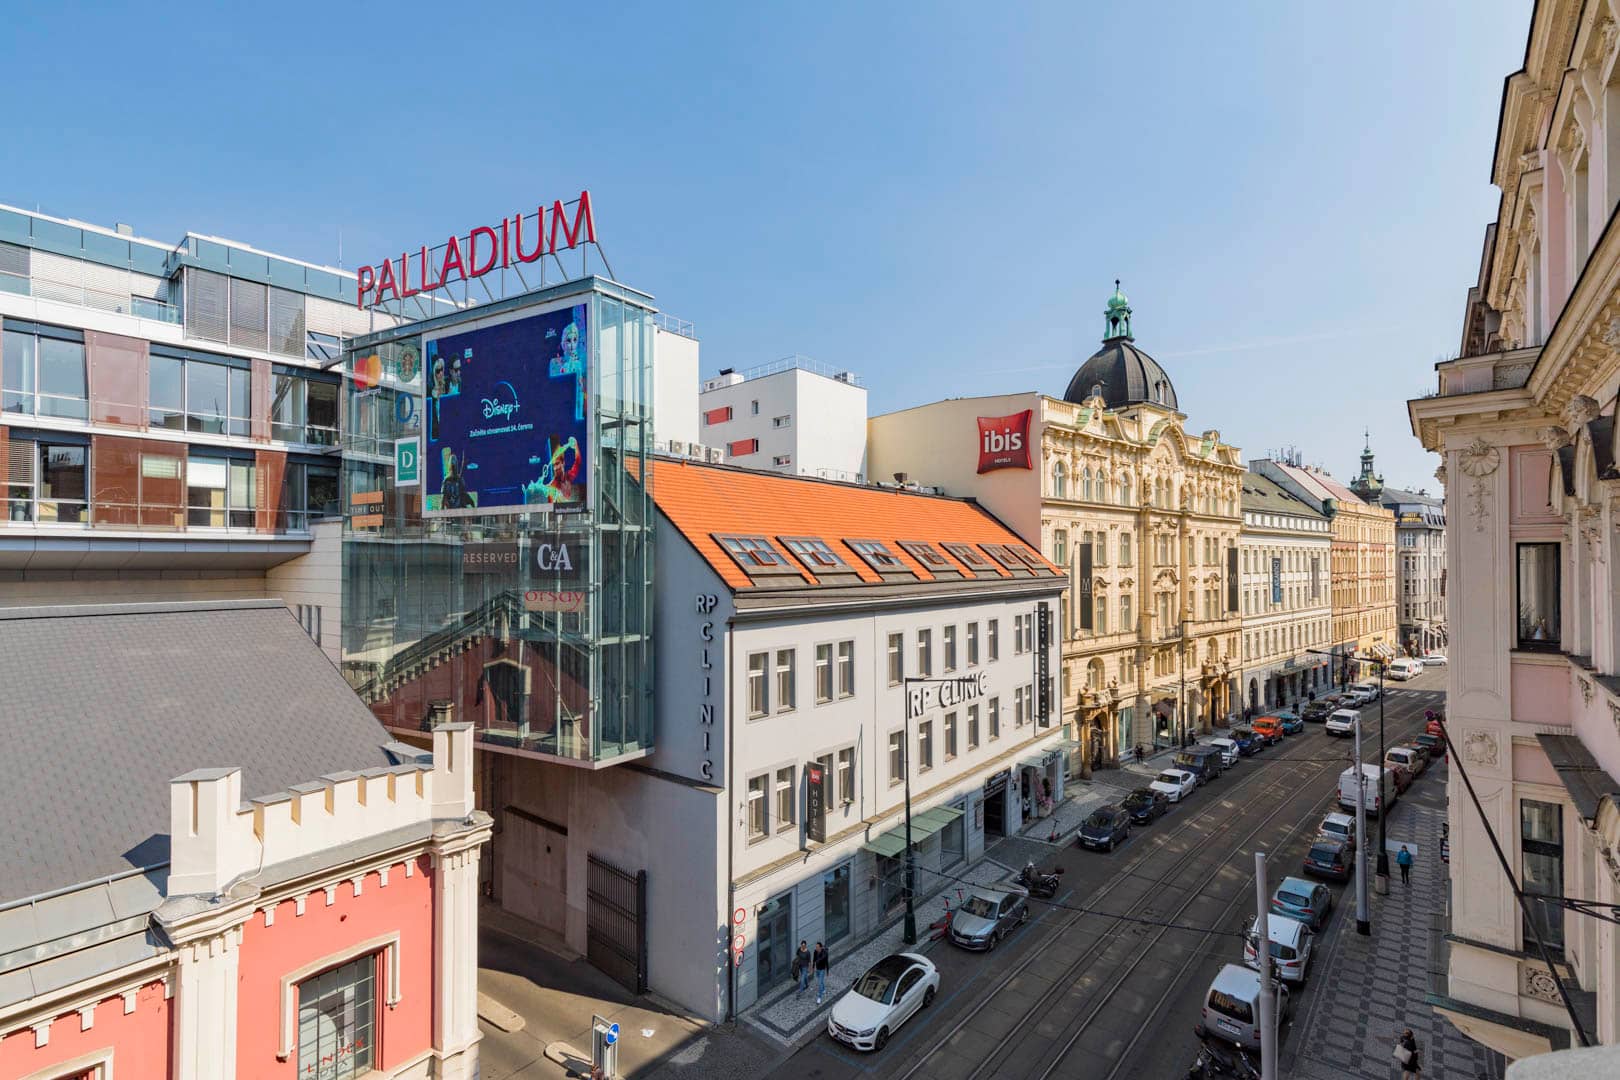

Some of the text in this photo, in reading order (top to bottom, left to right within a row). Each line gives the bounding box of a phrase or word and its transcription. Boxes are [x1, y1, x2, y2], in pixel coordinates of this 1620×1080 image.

[357, 190, 597, 311] PALLADIUM
[480, 398, 520, 420] Disney+
[984, 427, 1022, 453] ibis
[369, 503, 385, 513] OUT
[463, 552, 517, 563] RESERVED
[537, 543, 573, 570] C&A
[525, 591, 584, 613] orsay
[695, 594, 718, 614] RP
[700, 622, 714, 780] CLINIC
[908, 670, 989, 719] RP CLINIC
